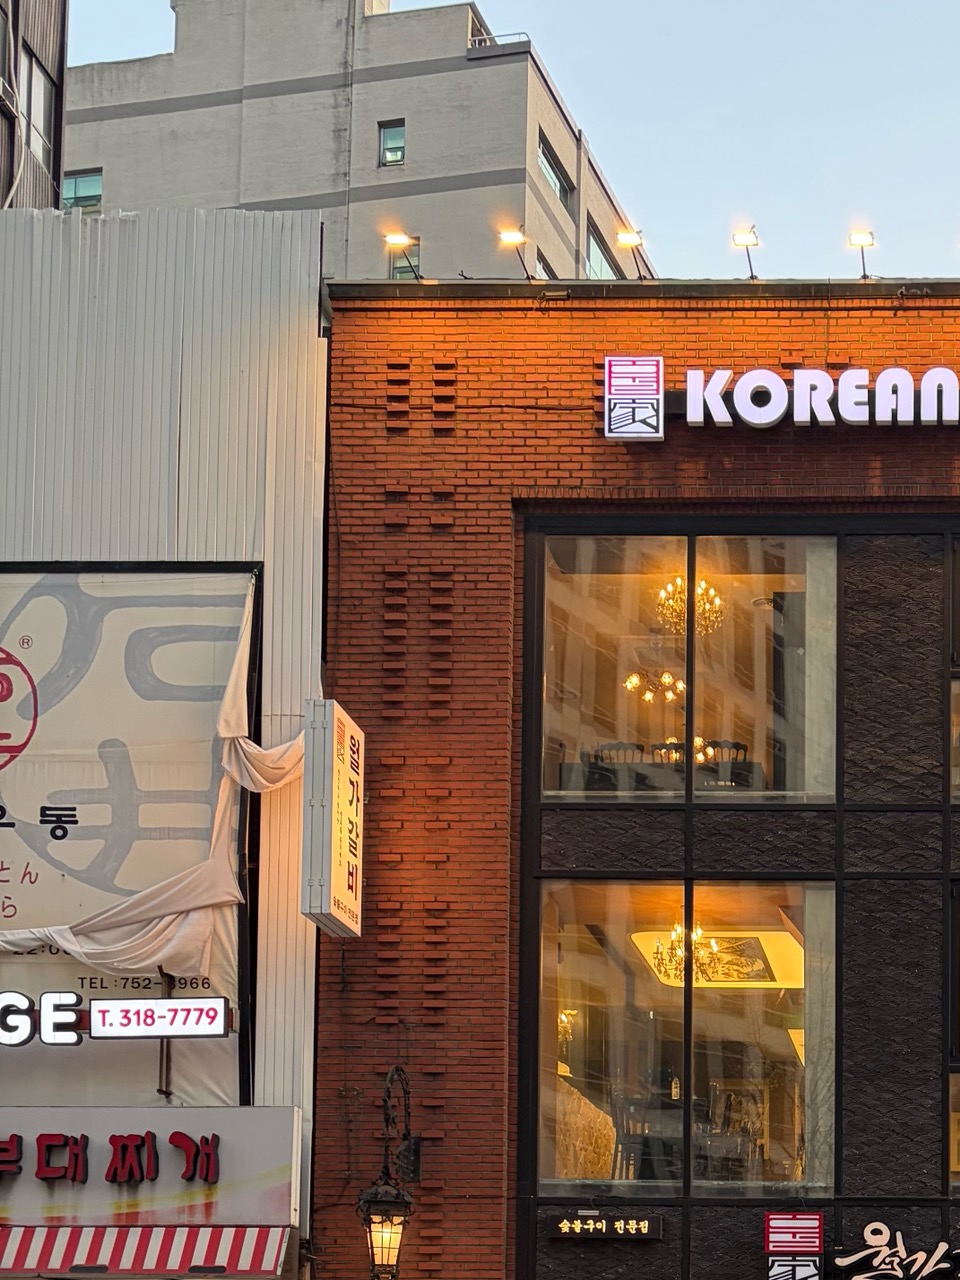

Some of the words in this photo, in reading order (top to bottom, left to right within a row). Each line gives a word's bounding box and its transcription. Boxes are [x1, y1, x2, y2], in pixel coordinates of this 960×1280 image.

[78, 976, 109, 990] TEL
[119, 1007, 219, 1028] 318-7779
[558, 1218, 607, 1235] 숯불구이
[613, 1219, 650, 1235] 전문점
